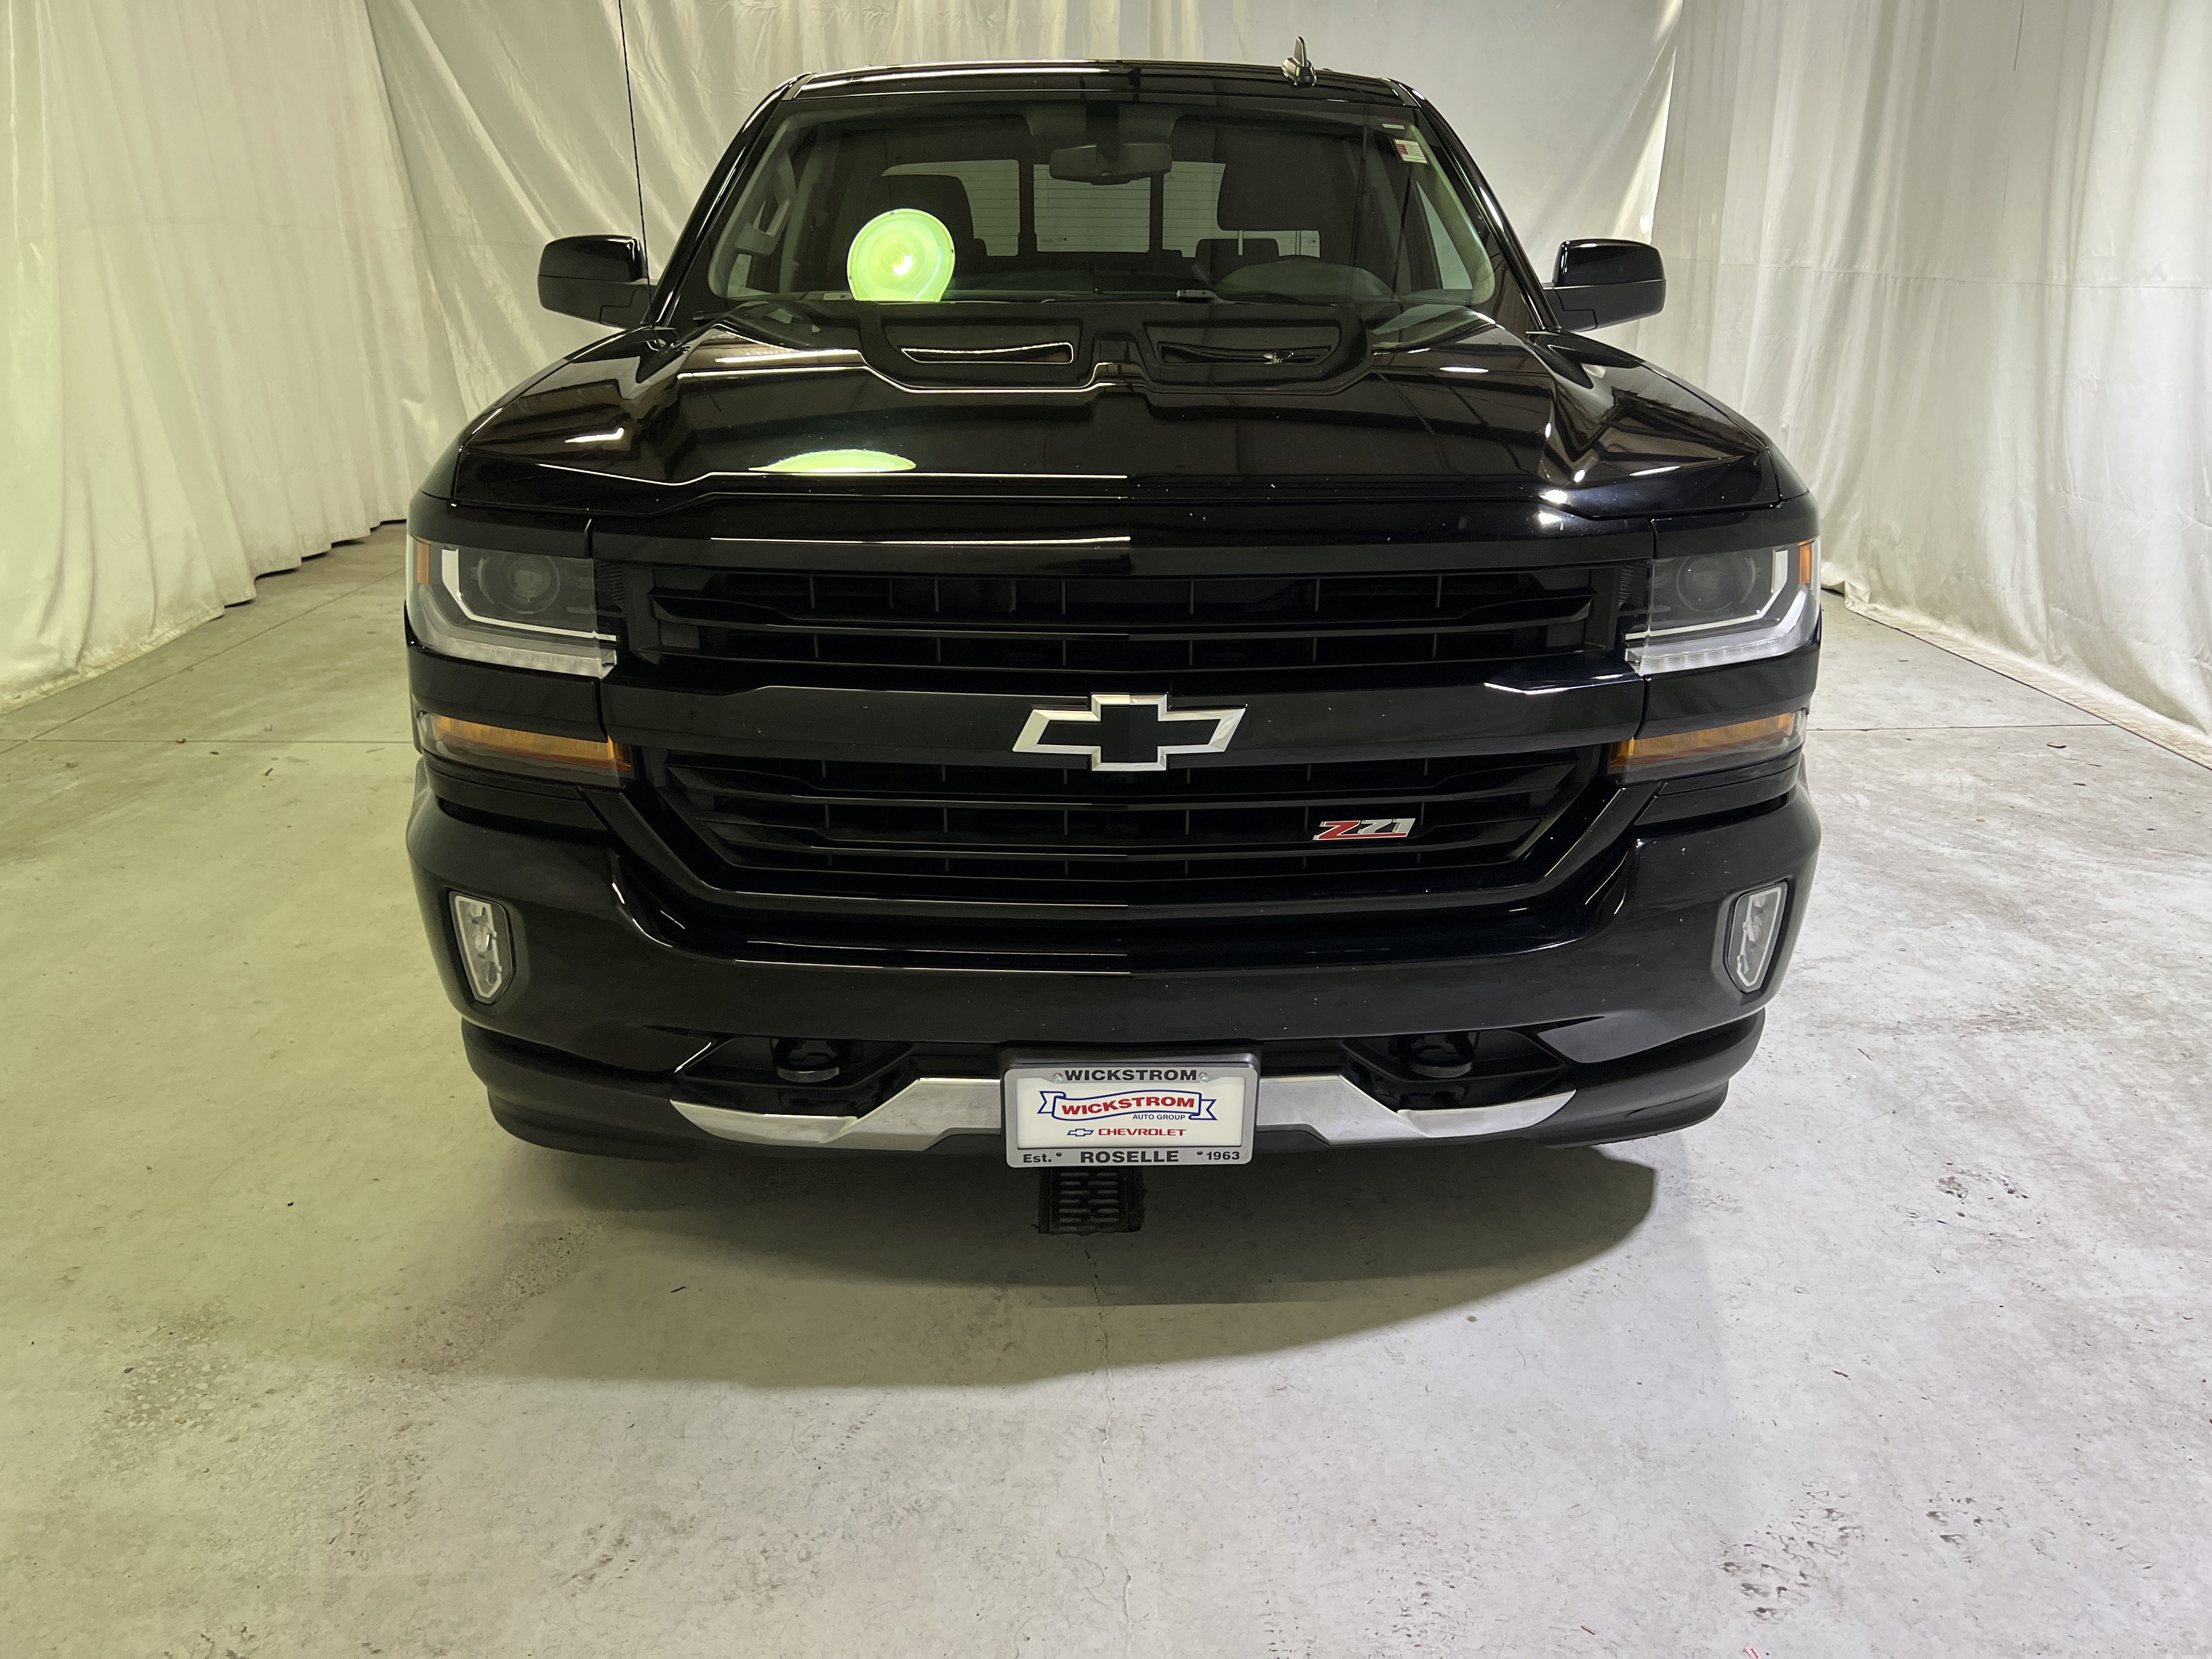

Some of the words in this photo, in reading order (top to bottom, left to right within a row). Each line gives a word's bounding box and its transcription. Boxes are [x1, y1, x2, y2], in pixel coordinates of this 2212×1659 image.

[1312, 819, 1415, 840] Z71
[1064, 1069, 1197, 1081] WICKSTROM
[1062, 1097, 1195, 1115] WICKSTROM
[1023, 1154, 1052, 1163] Est.
[1080, 1151, 1180, 1163] ROSELLE
[1207, 1151, 1240, 1160] 1963
